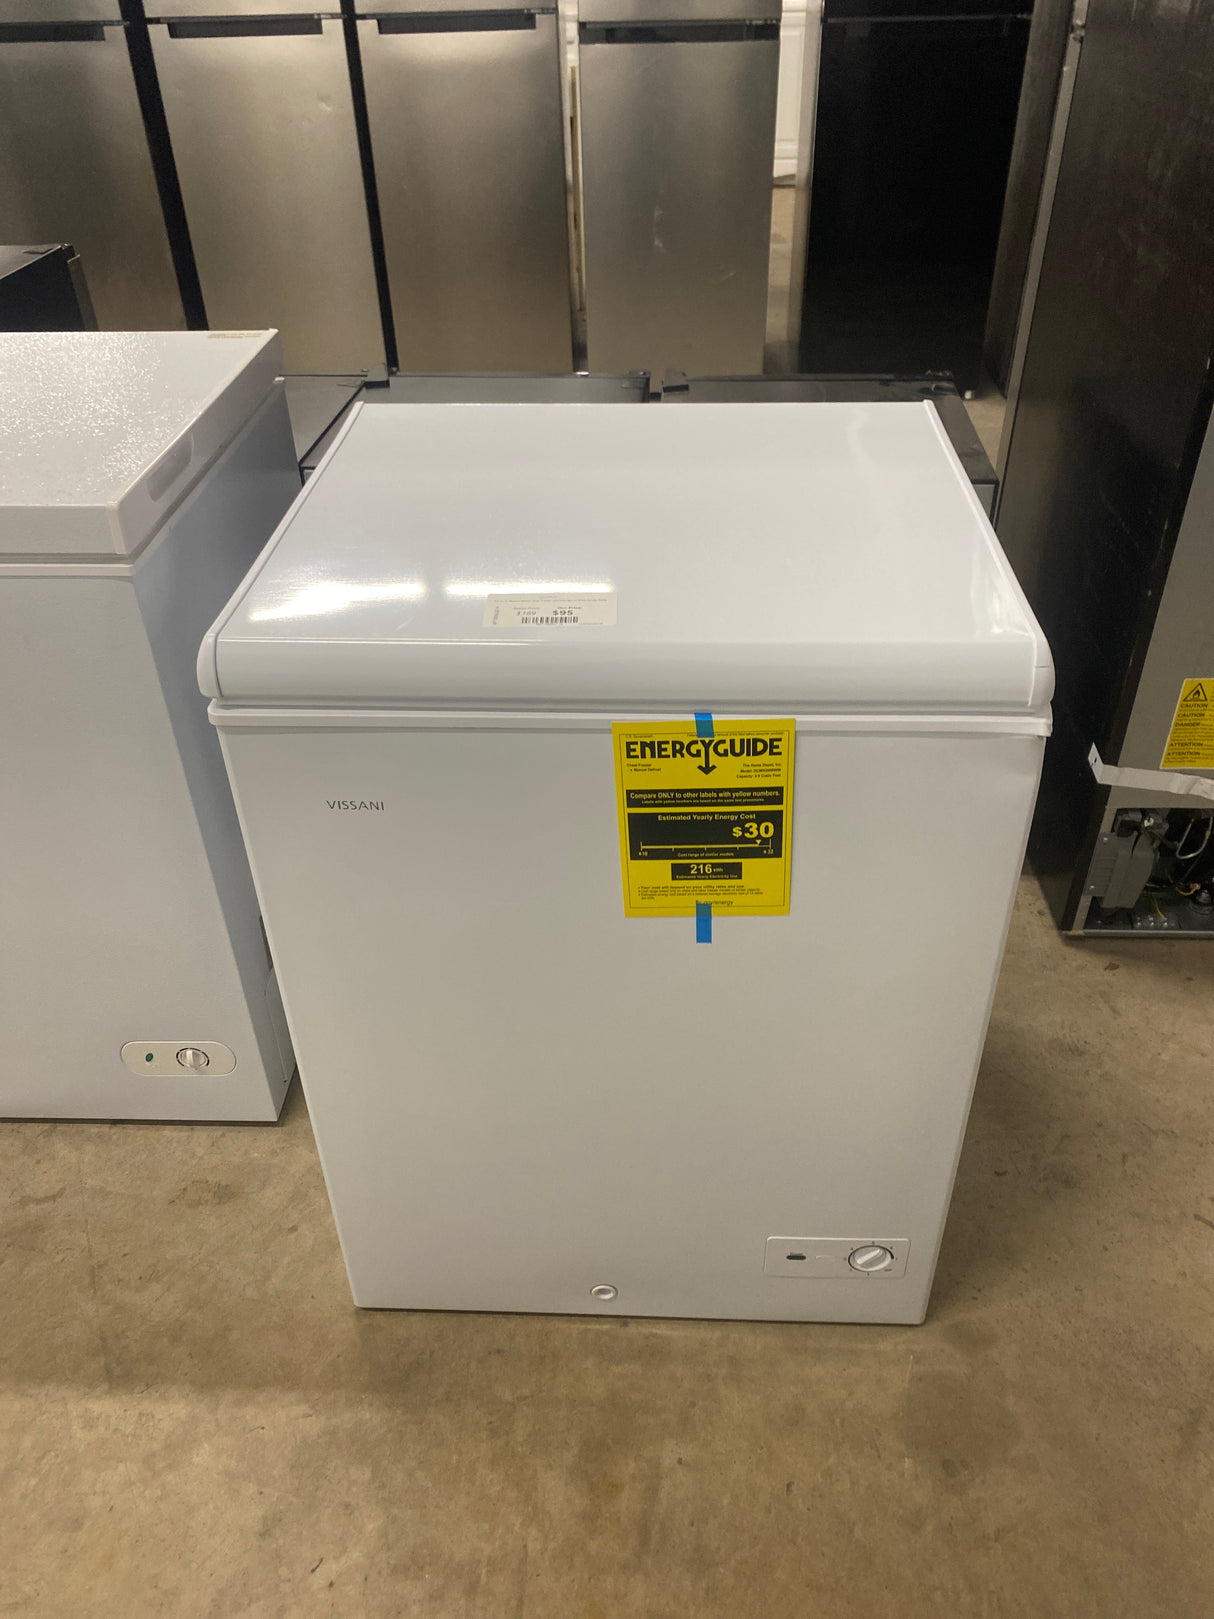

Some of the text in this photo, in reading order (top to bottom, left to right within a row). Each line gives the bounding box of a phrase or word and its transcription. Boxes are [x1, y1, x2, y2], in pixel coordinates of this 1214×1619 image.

[626, 737, 782, 759] ENERGYGUIDE
[630, 792, 656, 800] Compare
[326, 800, 385, 811] VISSANI
[732, 821, 774, 839] $30
[690, 864, 712, 874] 216
